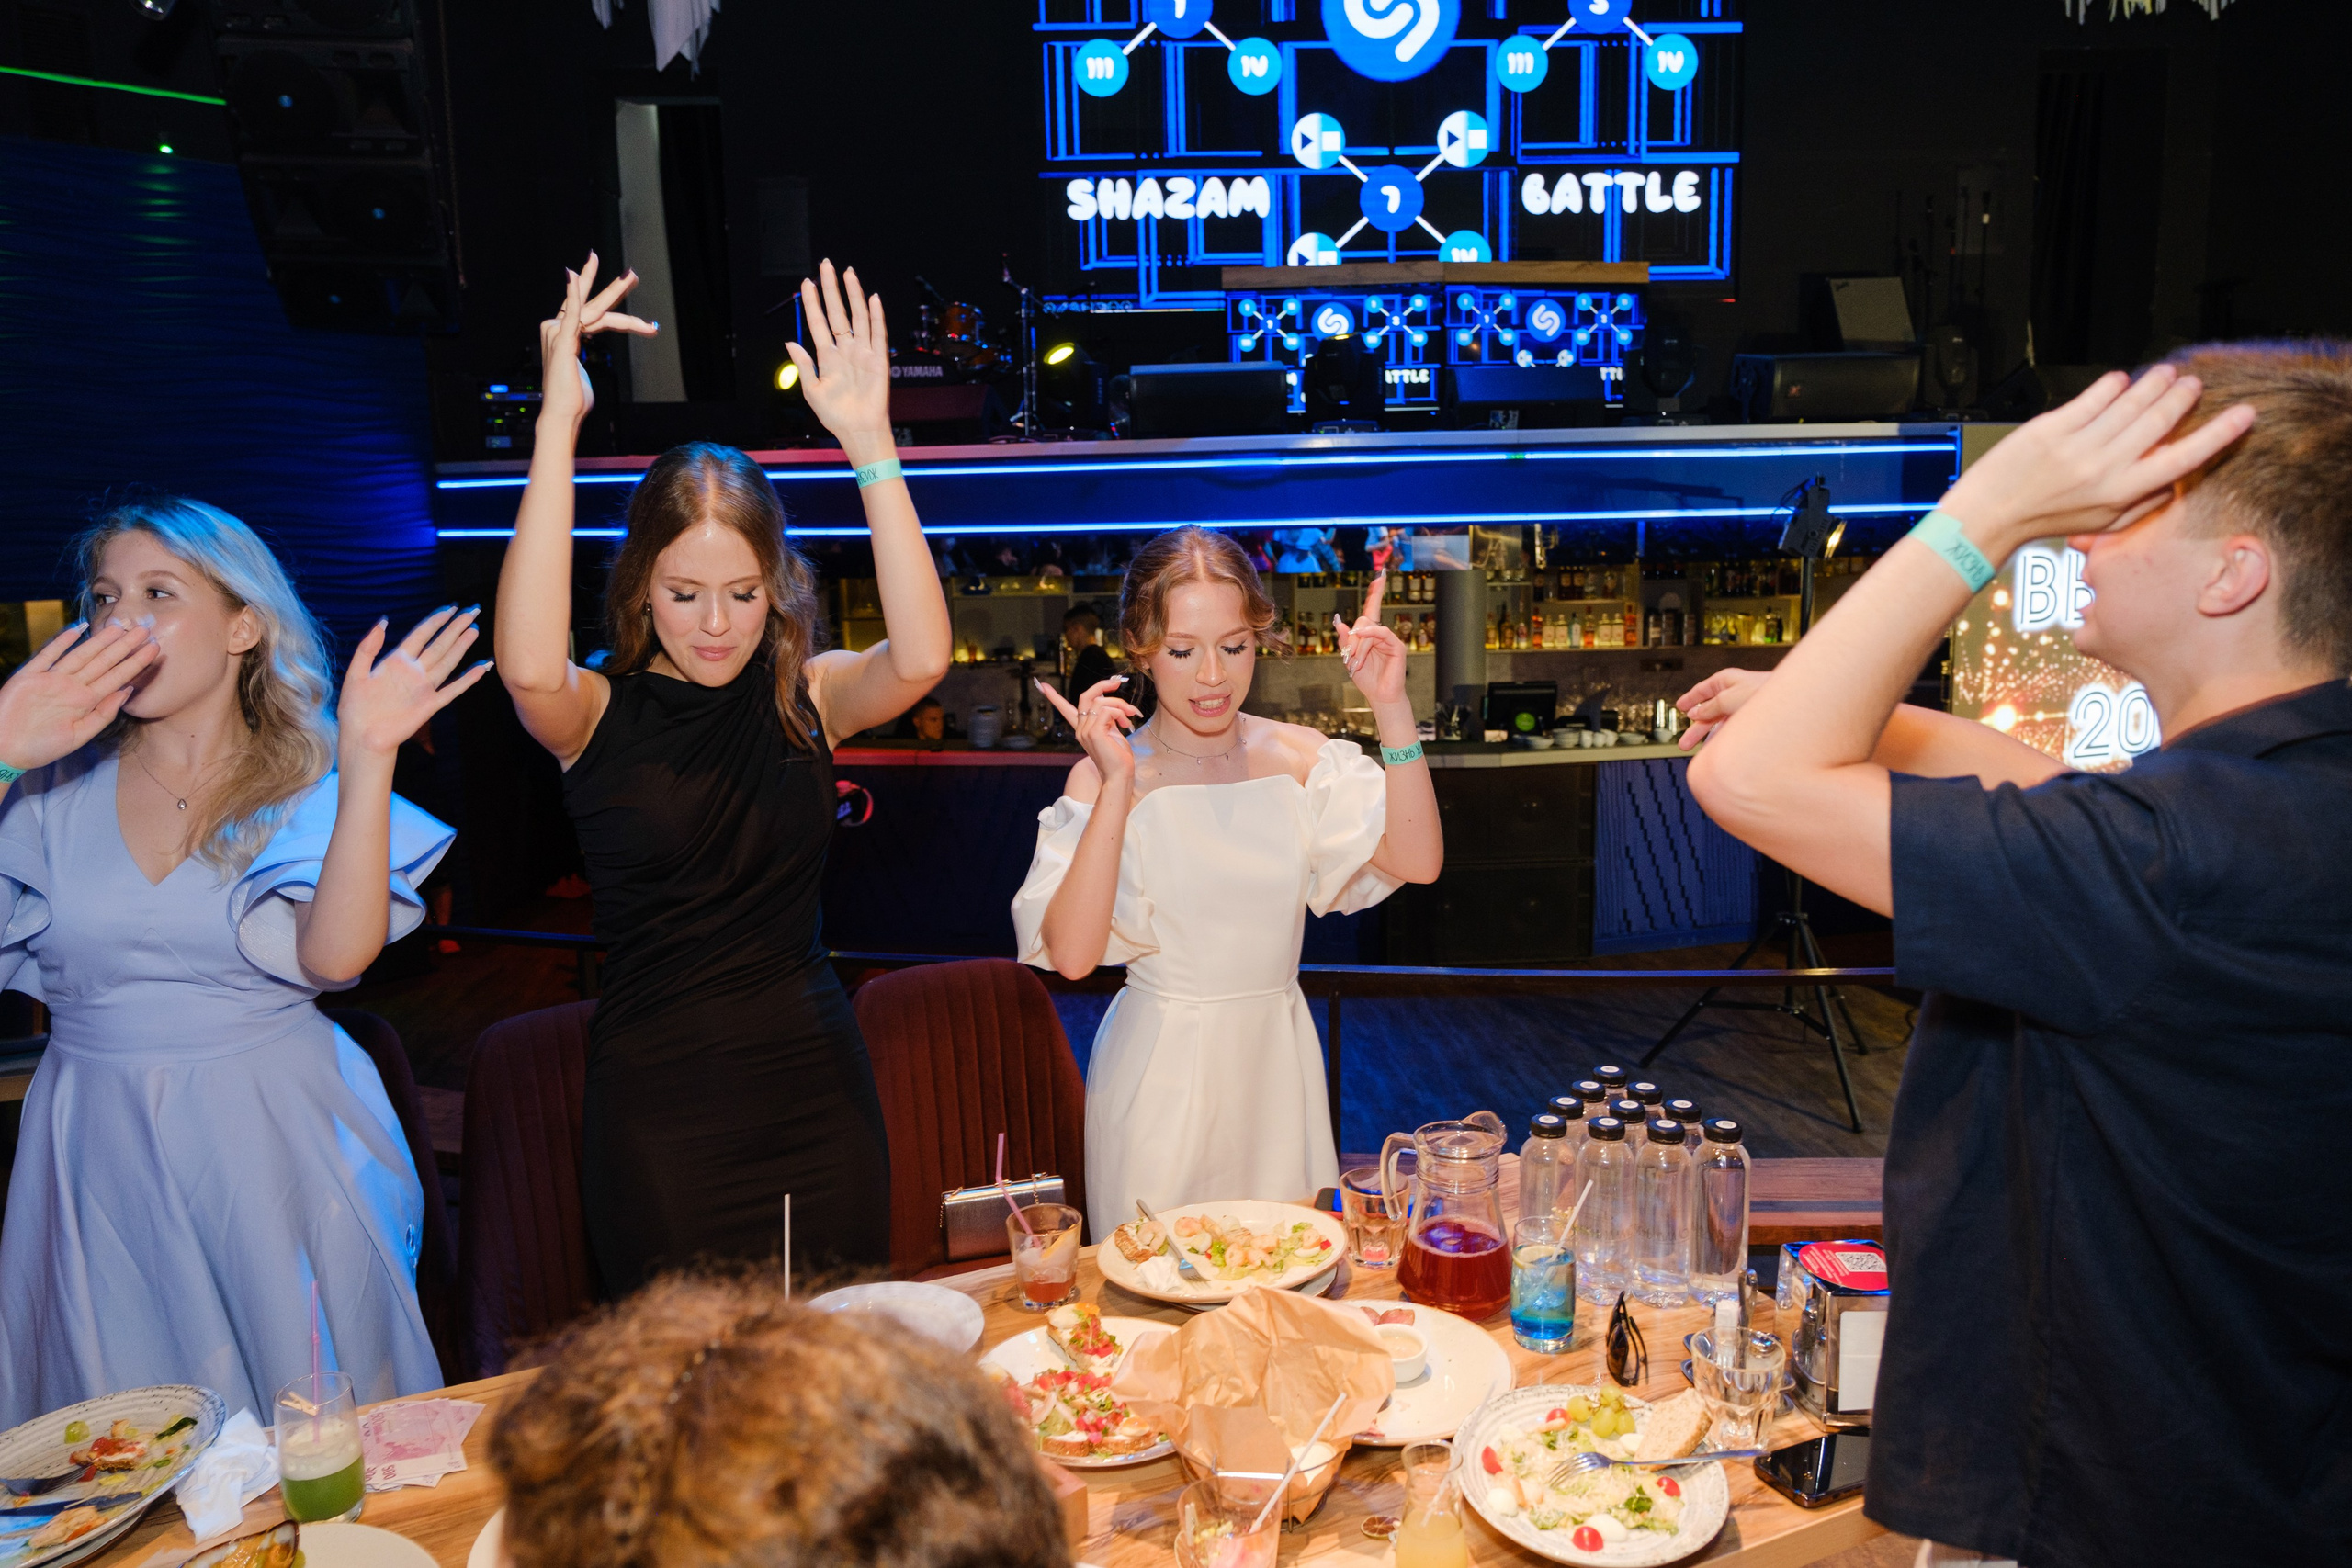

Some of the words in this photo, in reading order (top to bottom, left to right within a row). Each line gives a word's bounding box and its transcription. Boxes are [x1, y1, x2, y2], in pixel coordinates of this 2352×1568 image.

[1067, 176, 1270, 220] SHAZAM
[1521, 171, 1701, 215] BATTLE
[902, 365, 944, 378] YAMAHA
